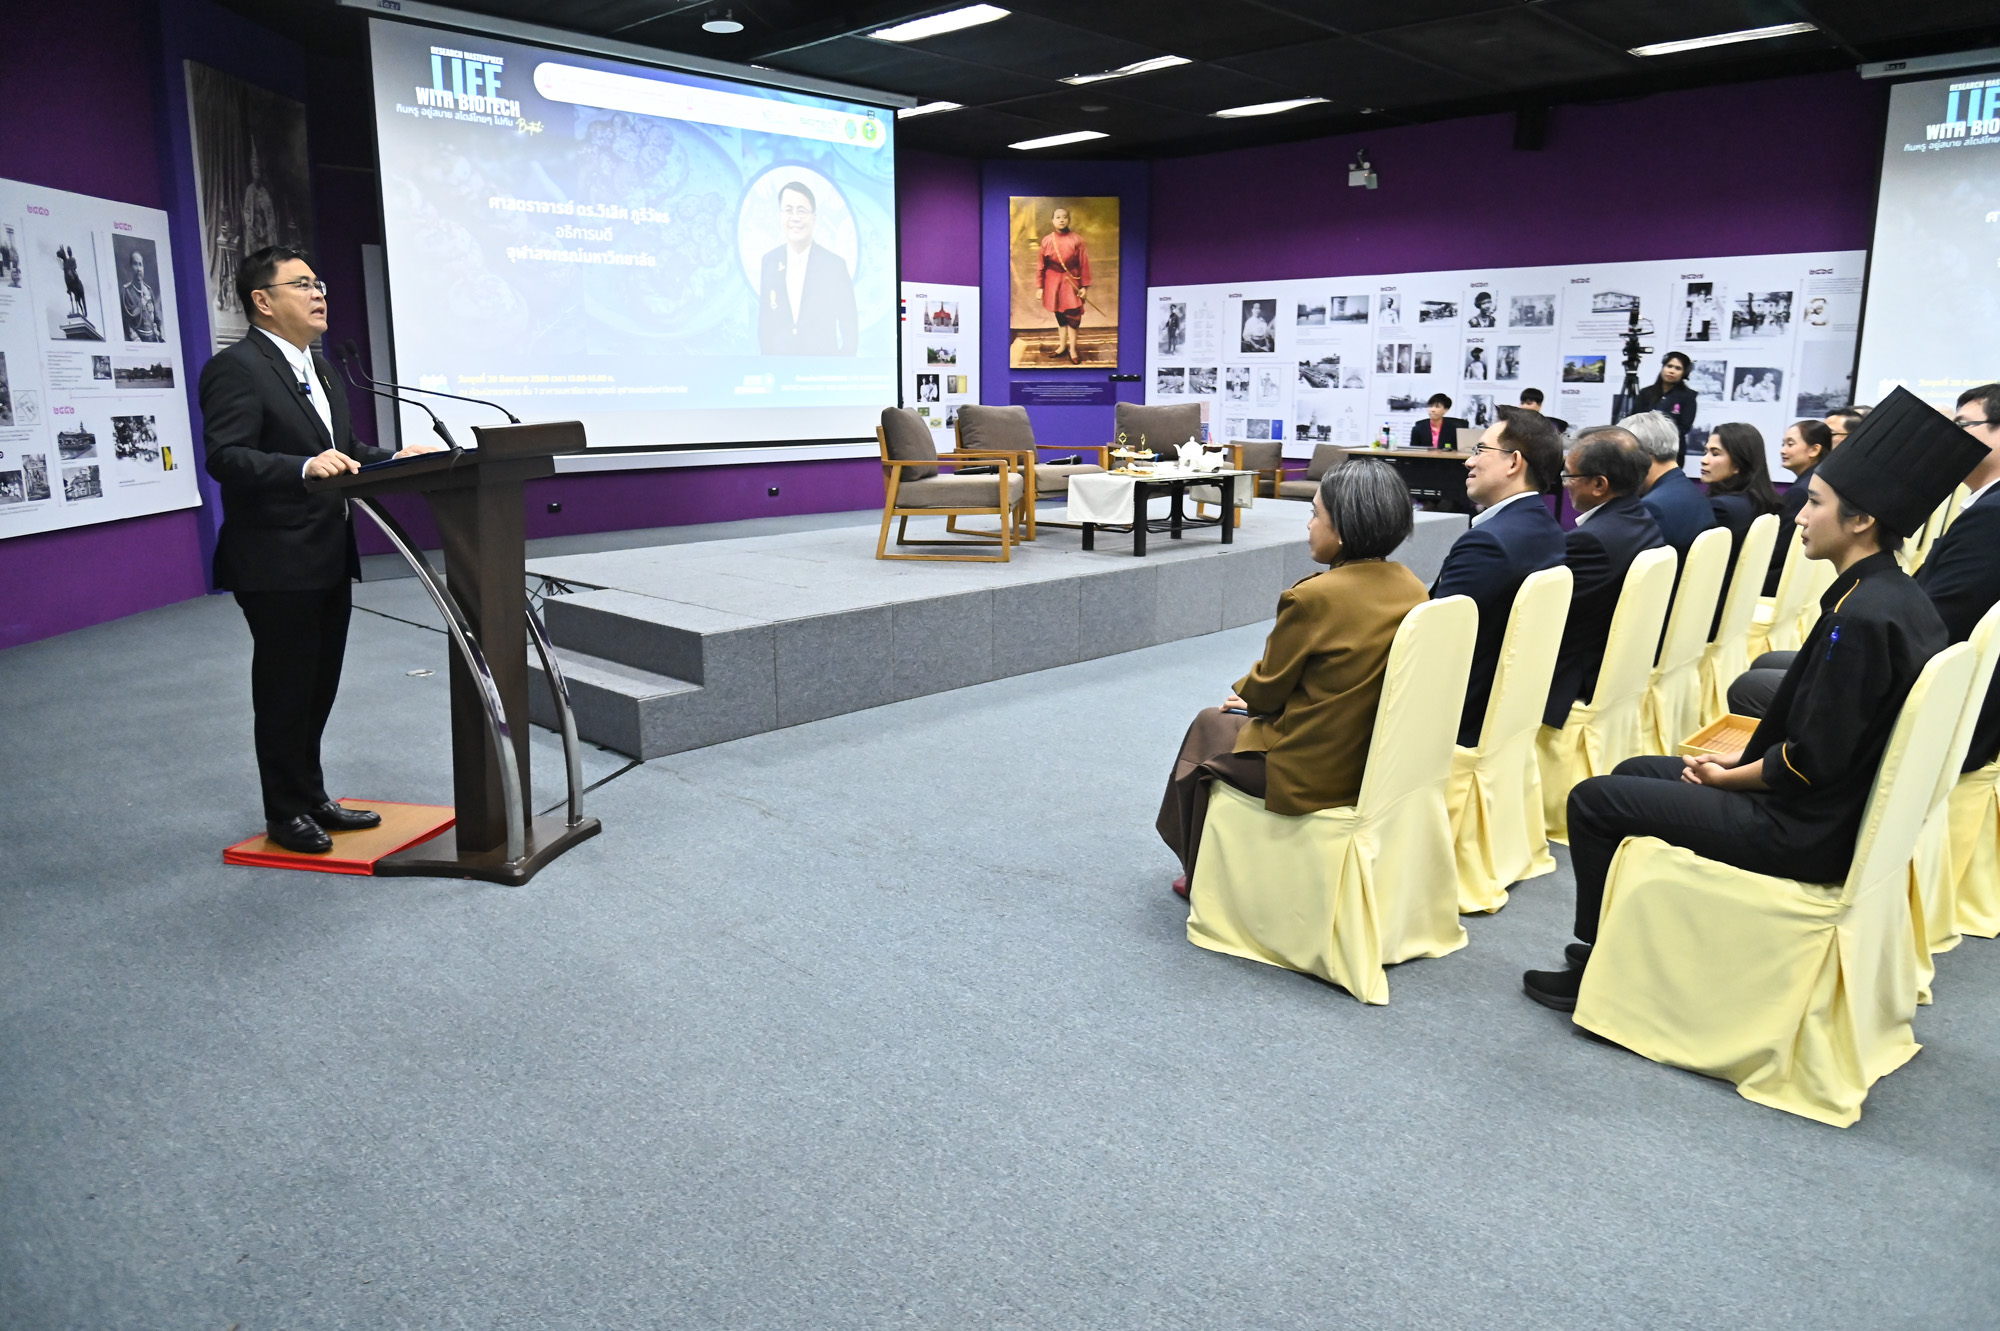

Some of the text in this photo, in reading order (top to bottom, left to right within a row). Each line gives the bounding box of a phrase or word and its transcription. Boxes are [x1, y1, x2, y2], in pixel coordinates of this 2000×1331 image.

[415, 86, 521, 118] WITH BIOTECH
[1926, 121, 1967, 140] WITH
[489, 197, 574, 215] ศาสตราจารย์
[555, 225, 613, 241] อธิการบดี
